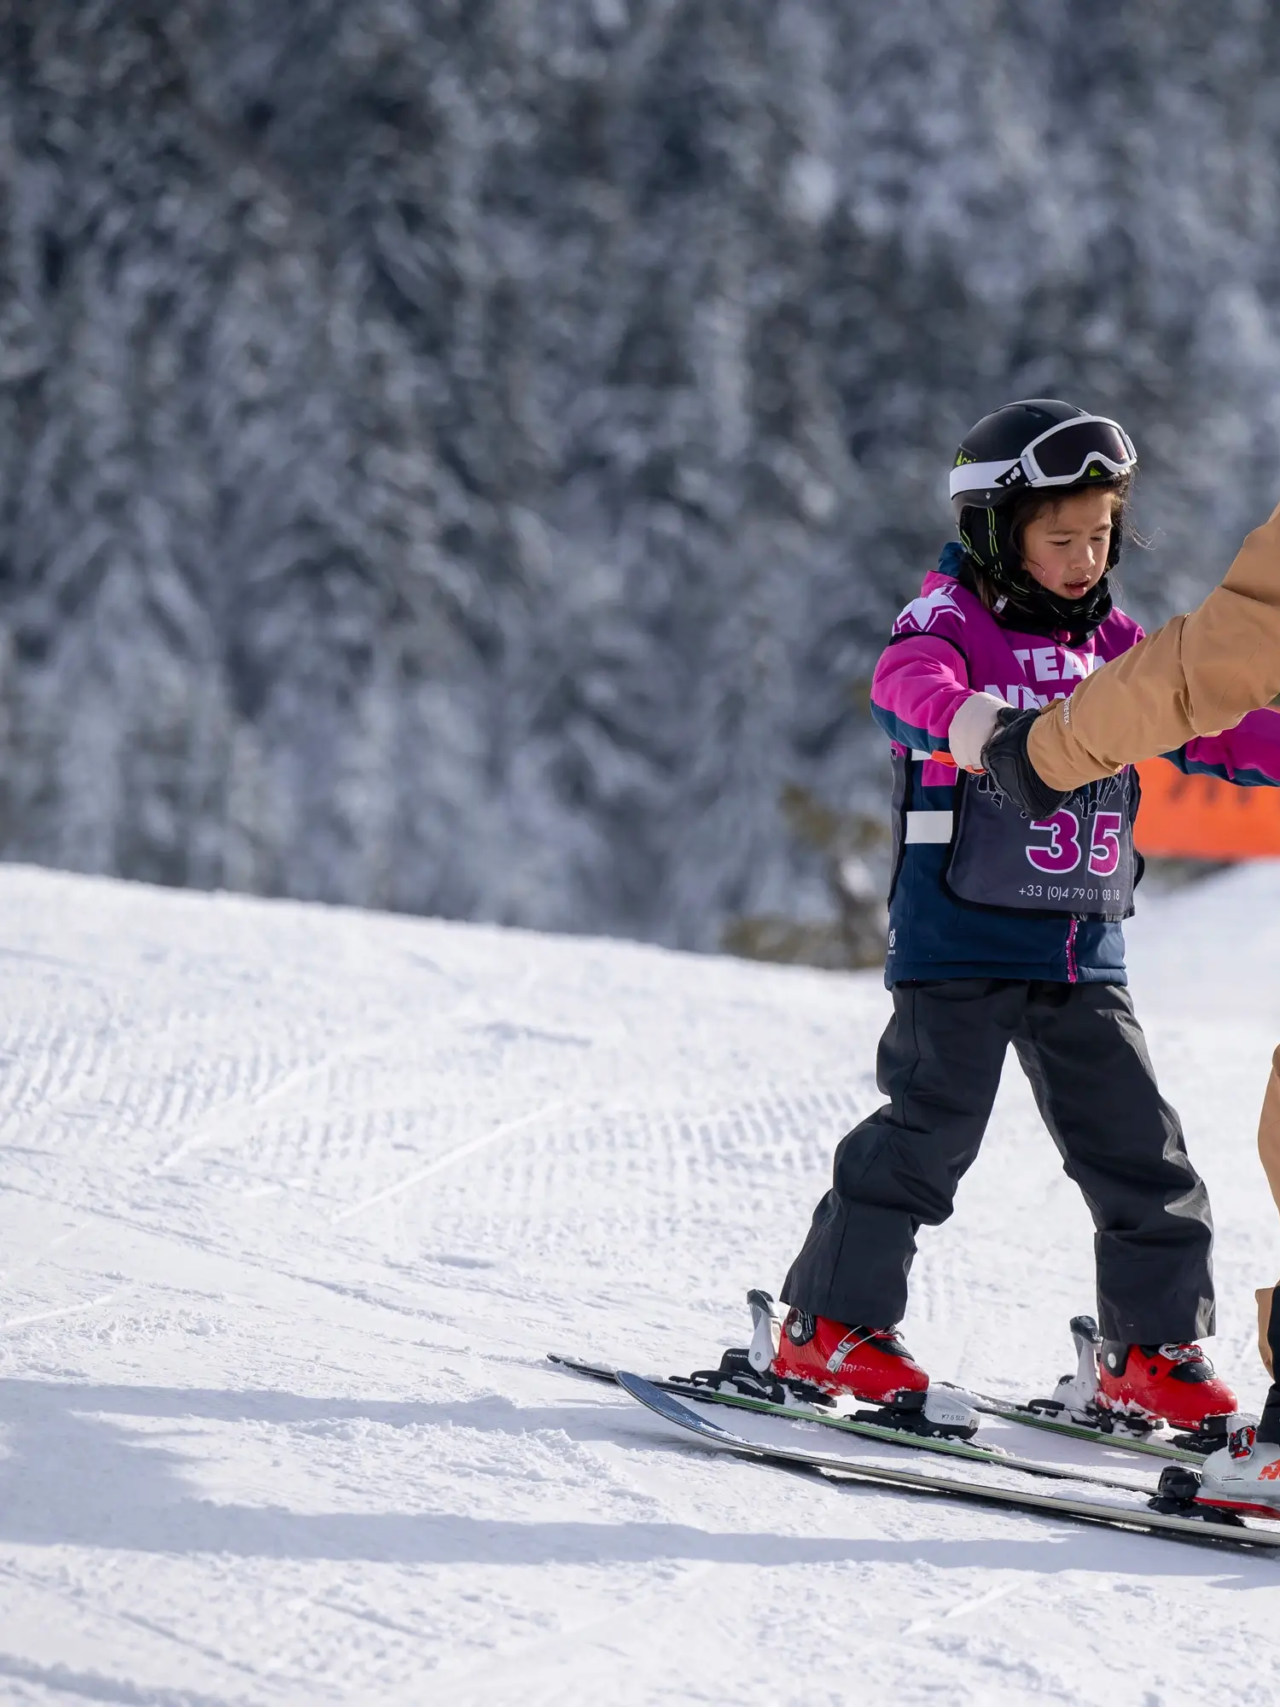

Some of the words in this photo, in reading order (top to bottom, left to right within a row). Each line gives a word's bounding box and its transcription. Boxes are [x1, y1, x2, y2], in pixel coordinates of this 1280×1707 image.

[1026, 808, 1121, 877] 35
[1019, 884, 1043, 897] +33
[1047, 885, 1069, 901] (0)4
[1071, 887, 1086, 900] 79
[1087, 888, 1098, 900] 01
[1102, 889, 1111, 901] 03
[1113, 889, 1120, 901] 18
